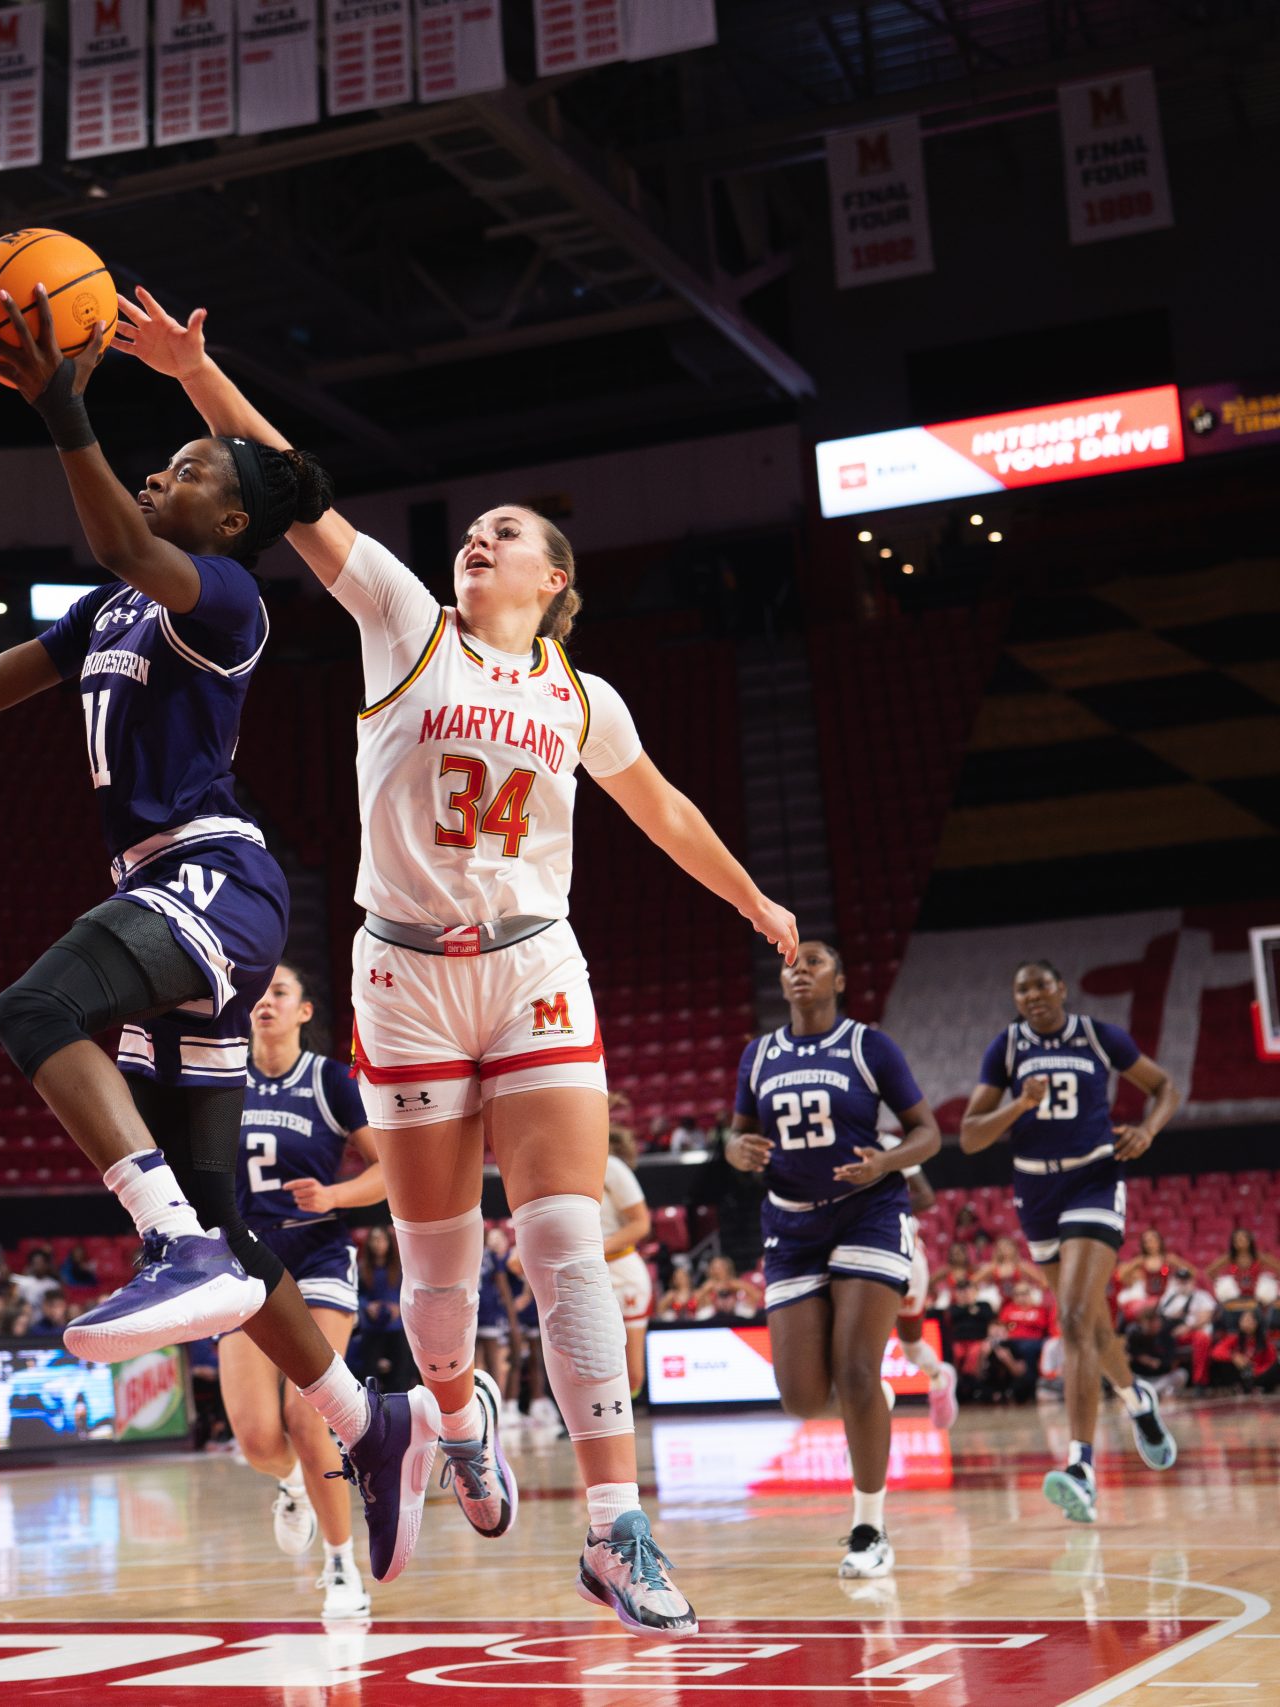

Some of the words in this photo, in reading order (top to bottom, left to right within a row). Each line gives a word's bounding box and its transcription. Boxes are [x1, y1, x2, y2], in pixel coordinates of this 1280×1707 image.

[1075, 133, 1149, 165] FINAL
[1081, 157, 1148, 188] FOUR
[842, 181, 911, 211] FINAL
[848, 204, 910, 232] FOUR
[971, 410, 1122, 456] INTENSIFY
[994, 441, 1075, 474] YOUR
[1079, 424, 1171, 461] DRIVE
[80, 649, 151, 687] HWESTERN
[417, 704, 566, 775] MARYLAND
[434, 753, 537, 858] 34
[530, 991, 573, 1031] M
[759, 1068, 850, 1101] NORTHWESTERN
[772, 1089, 836, 1150] 23
[246, 1132, 282, 1194] 2
